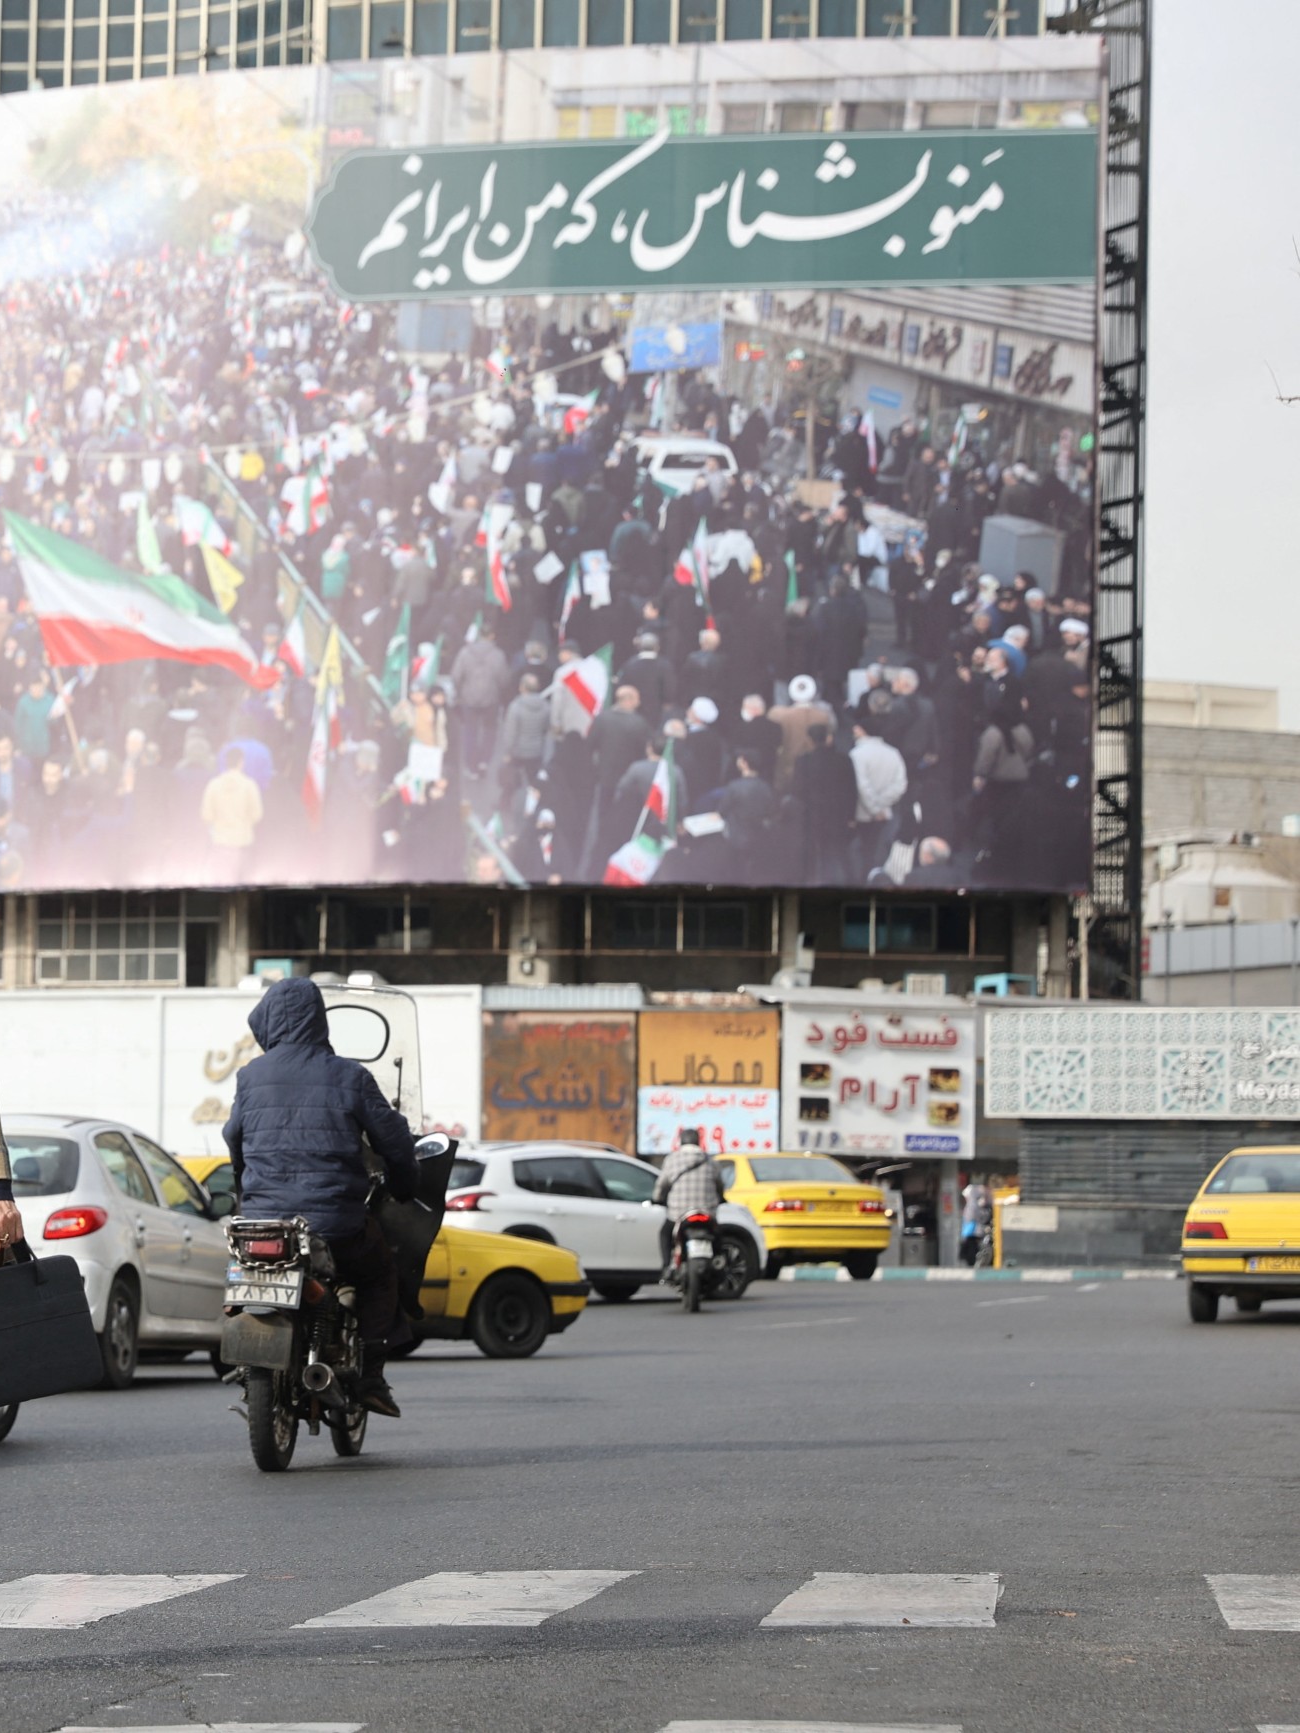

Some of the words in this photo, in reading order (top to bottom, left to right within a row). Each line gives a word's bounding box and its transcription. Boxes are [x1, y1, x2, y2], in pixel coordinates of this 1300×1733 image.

[357, 153, 497, 290] ایرانم
[552, 127, 672, 248] که
[462, 182, 570, 285] من
[806, 1011, 868, 1054] فود
[878, 1014, 958, 1047] فست
[490, 1061, 628, 1134] پاشیک
[839, 1074, 921, 1113] آرام
